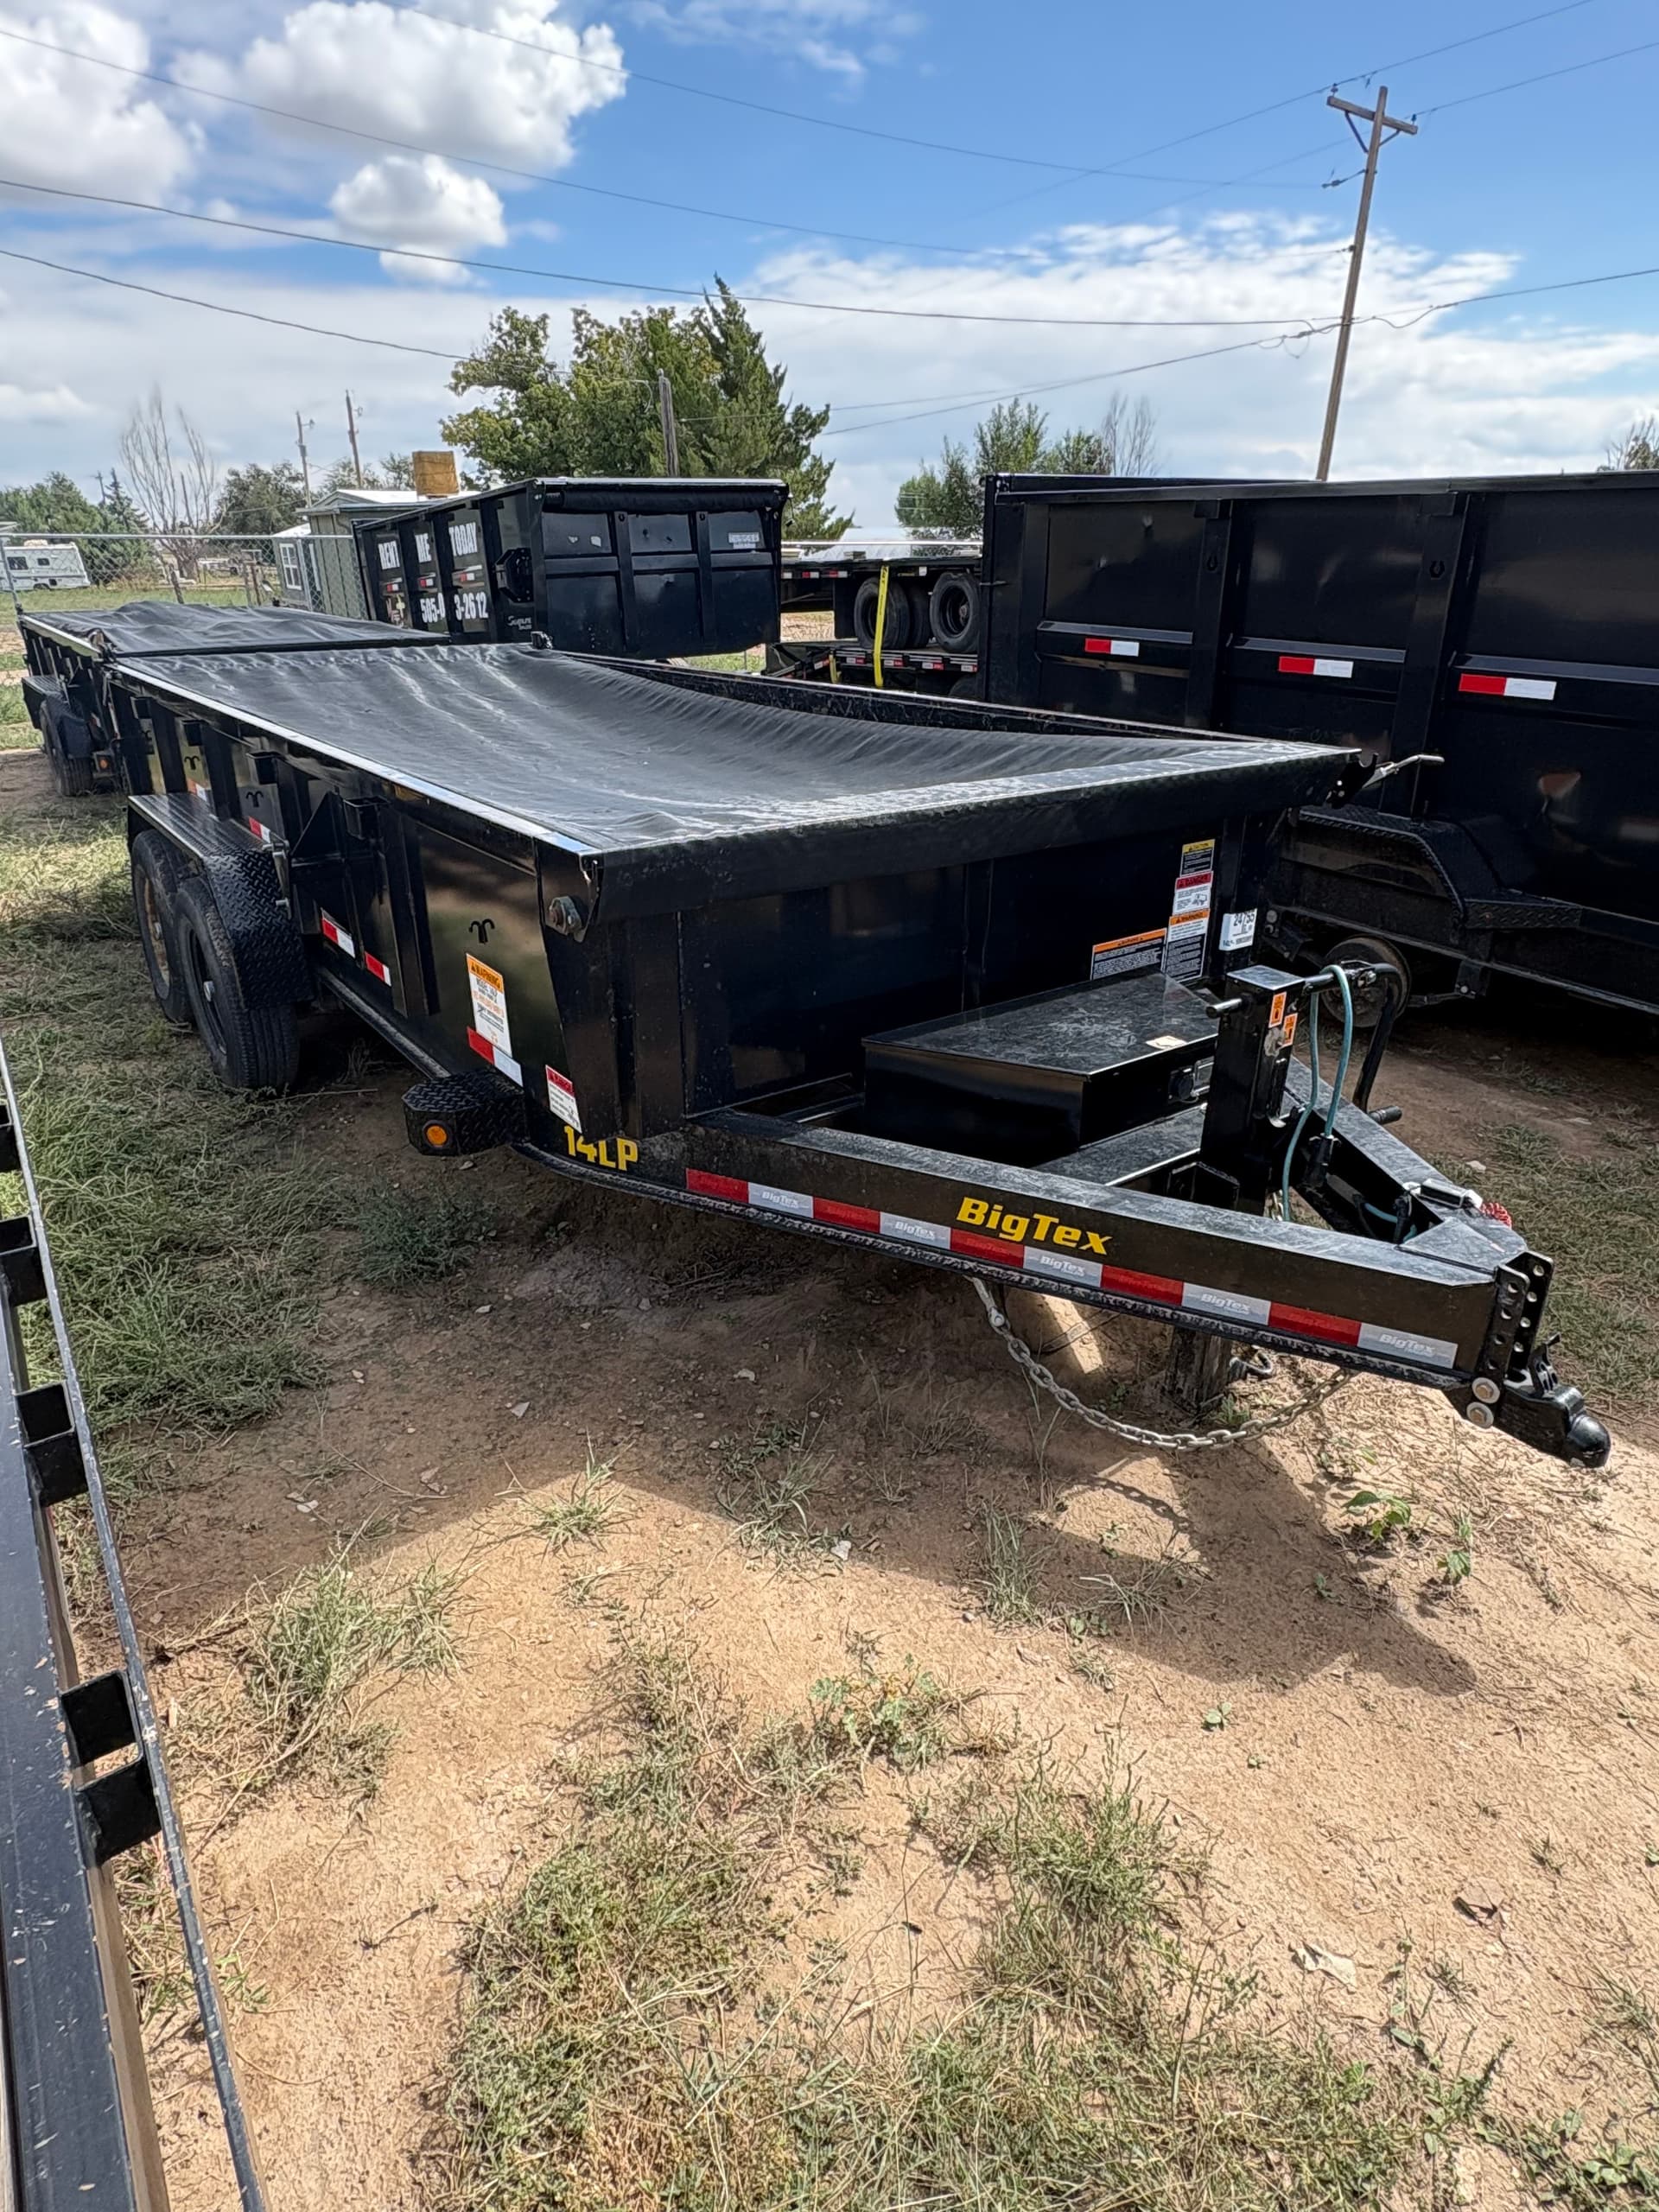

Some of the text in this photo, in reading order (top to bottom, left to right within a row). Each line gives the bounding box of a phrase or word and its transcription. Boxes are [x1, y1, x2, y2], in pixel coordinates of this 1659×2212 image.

[378, 522, 478, 569] RENT ME TODAY
[563, 1125, 639, 1171] 14LP
[761, 1190, 799, 1208] BigTex
[895, 1220, 936, 1239] BigTex
[957, 1197, 1113, 1255] BigTex
[1039, 1255, 1085, 1275] BigTex
[1200, 1292, 1252, 1313] BigTex
[1377, 1332, 1436, 1354] BigTex
